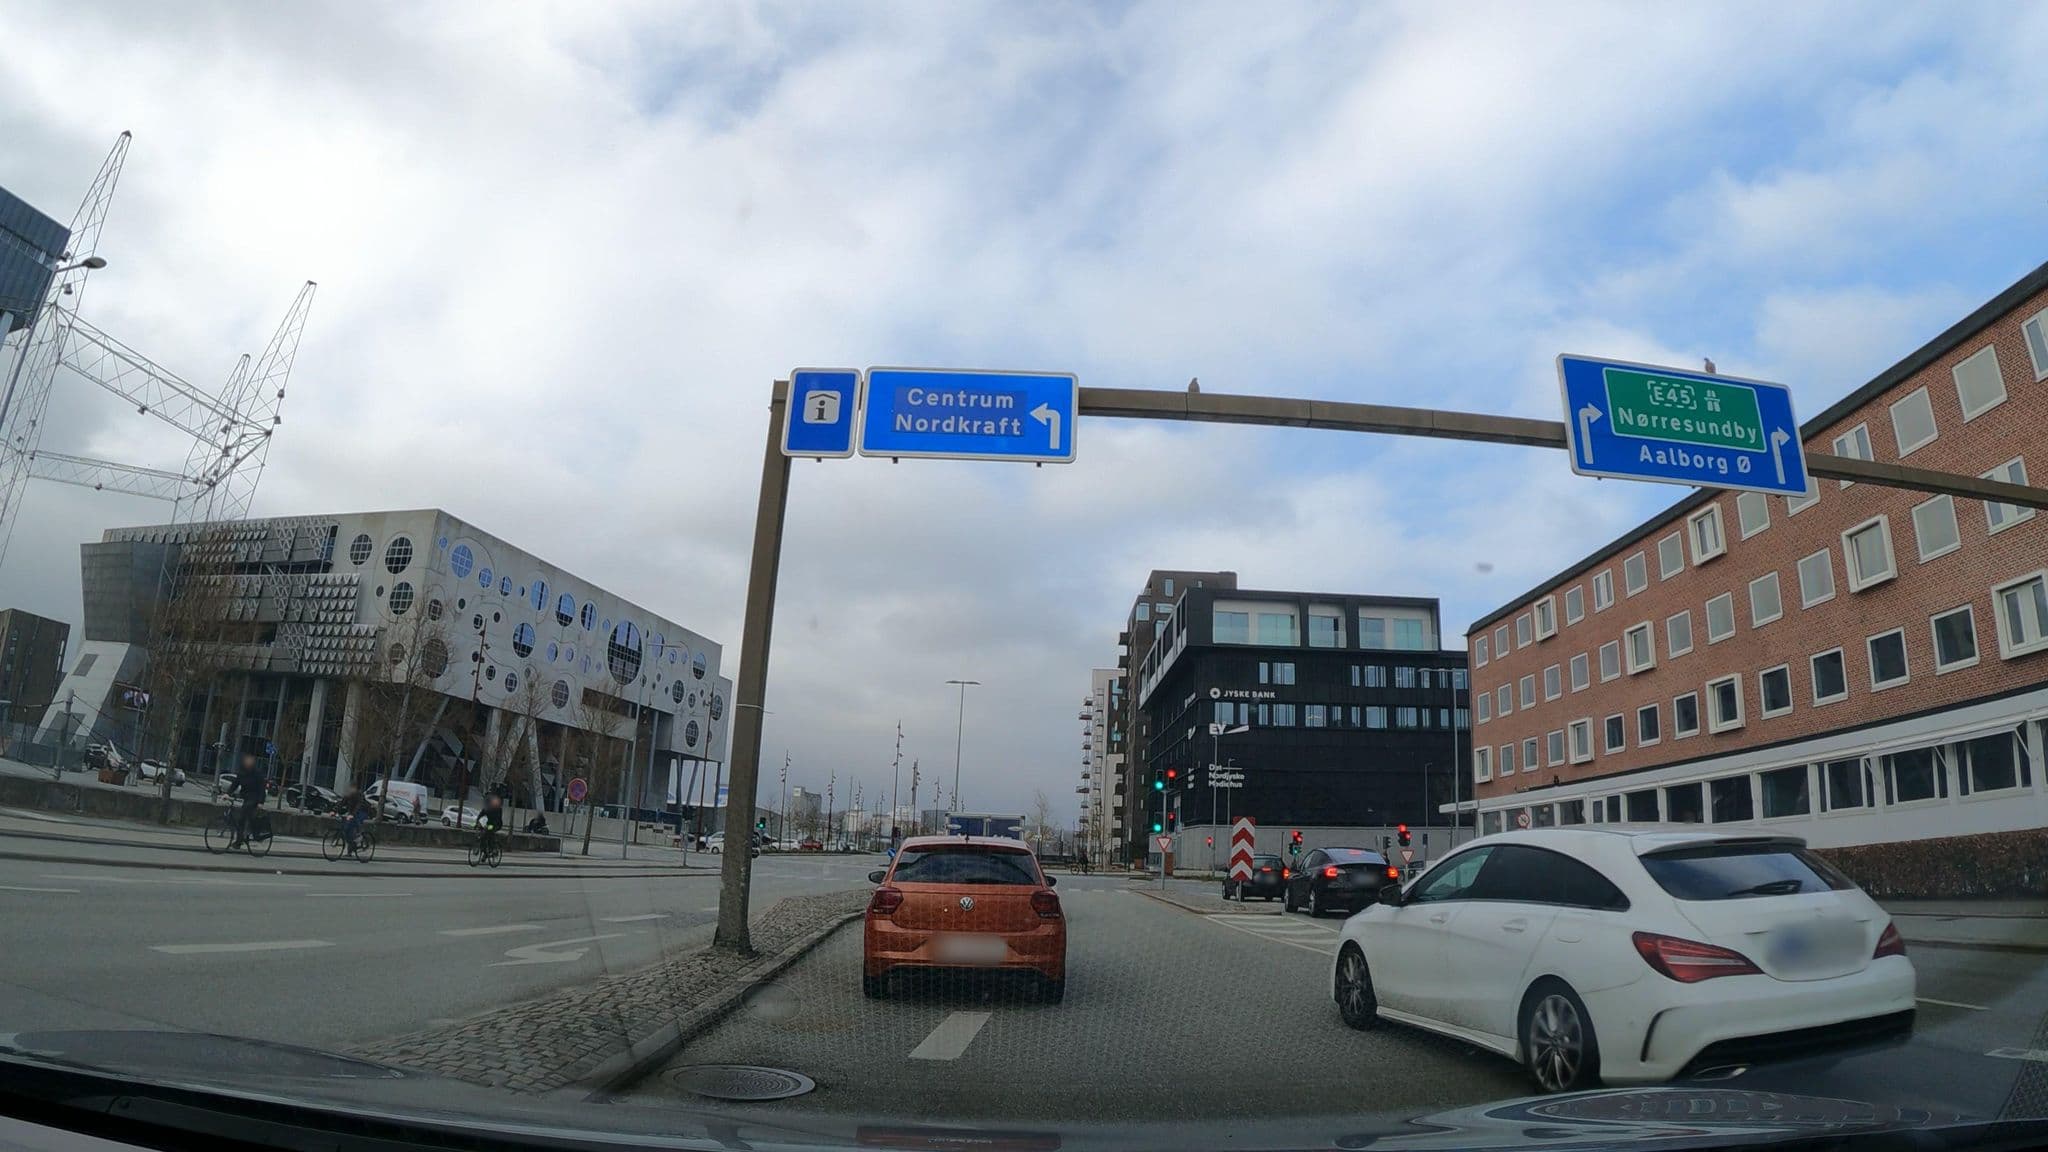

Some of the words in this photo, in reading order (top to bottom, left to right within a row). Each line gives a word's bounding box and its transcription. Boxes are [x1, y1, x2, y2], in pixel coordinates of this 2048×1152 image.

[907, 387, 1014, 409] Centrum
[1653, 385, 1691, 404] E45
[895, 414, 1021, 436] Nordkraft
[1618, 407, 1757, 443] Nørresundby
[1639, 444, 1729, 475] Aalborg
[1736, 455, 1751, 474] Ø
[1224, 690, 1250, 698] JYSKE
[1252, 691, 1276, 699] BANK
[1209, 722, 1227, 735] EY
